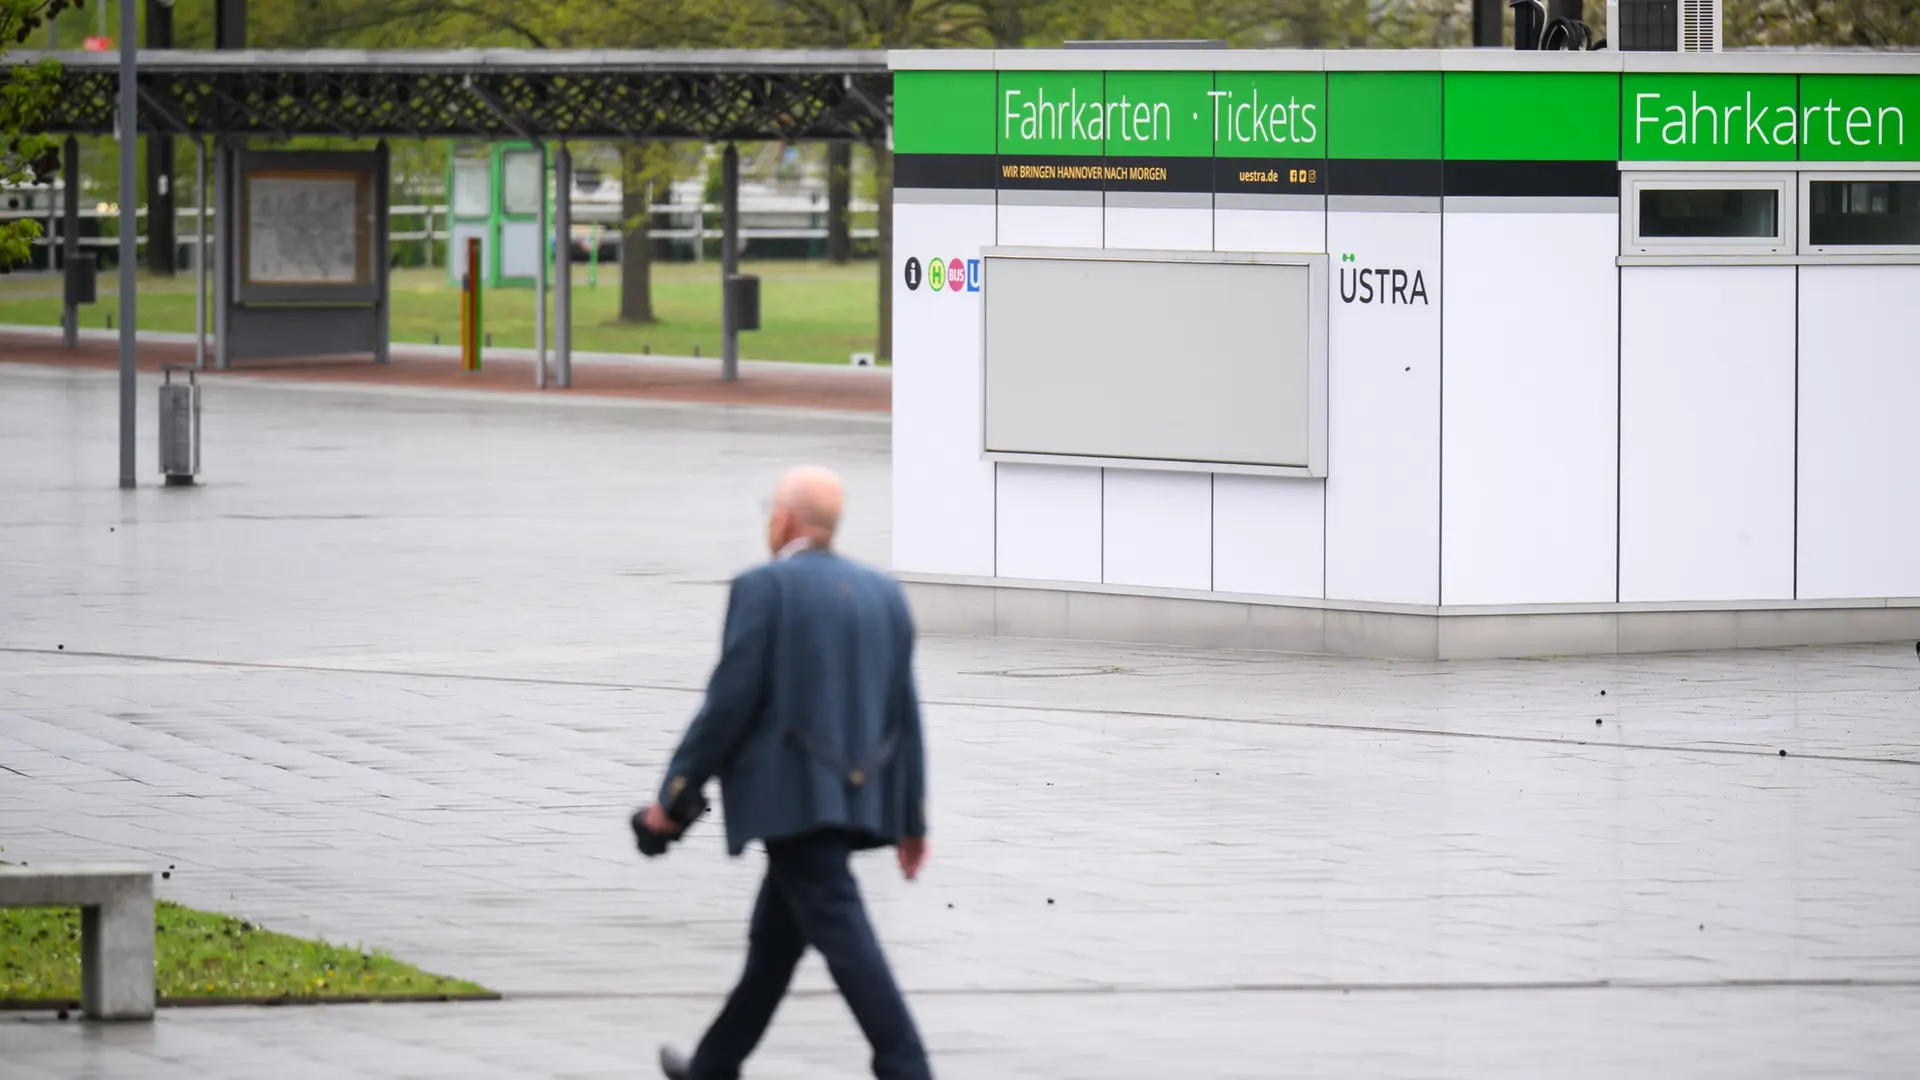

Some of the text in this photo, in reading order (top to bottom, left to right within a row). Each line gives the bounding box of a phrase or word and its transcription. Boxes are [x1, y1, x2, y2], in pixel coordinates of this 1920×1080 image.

[1005, 87, 1171, 141] Fahrkarten
[1207, 88, 1317, 143] Tickets
[1635, 90, 1904, 145] Fahrkarten
[1002, 165, 1167, 181] WIR BRINGEN HANNOVER NACH MORGEN
[1239, 169, 1279, 183] uestra.de
[948, 268, 965, 282] BUS
[1340, 253, 1429, 305] ÜSTRA
